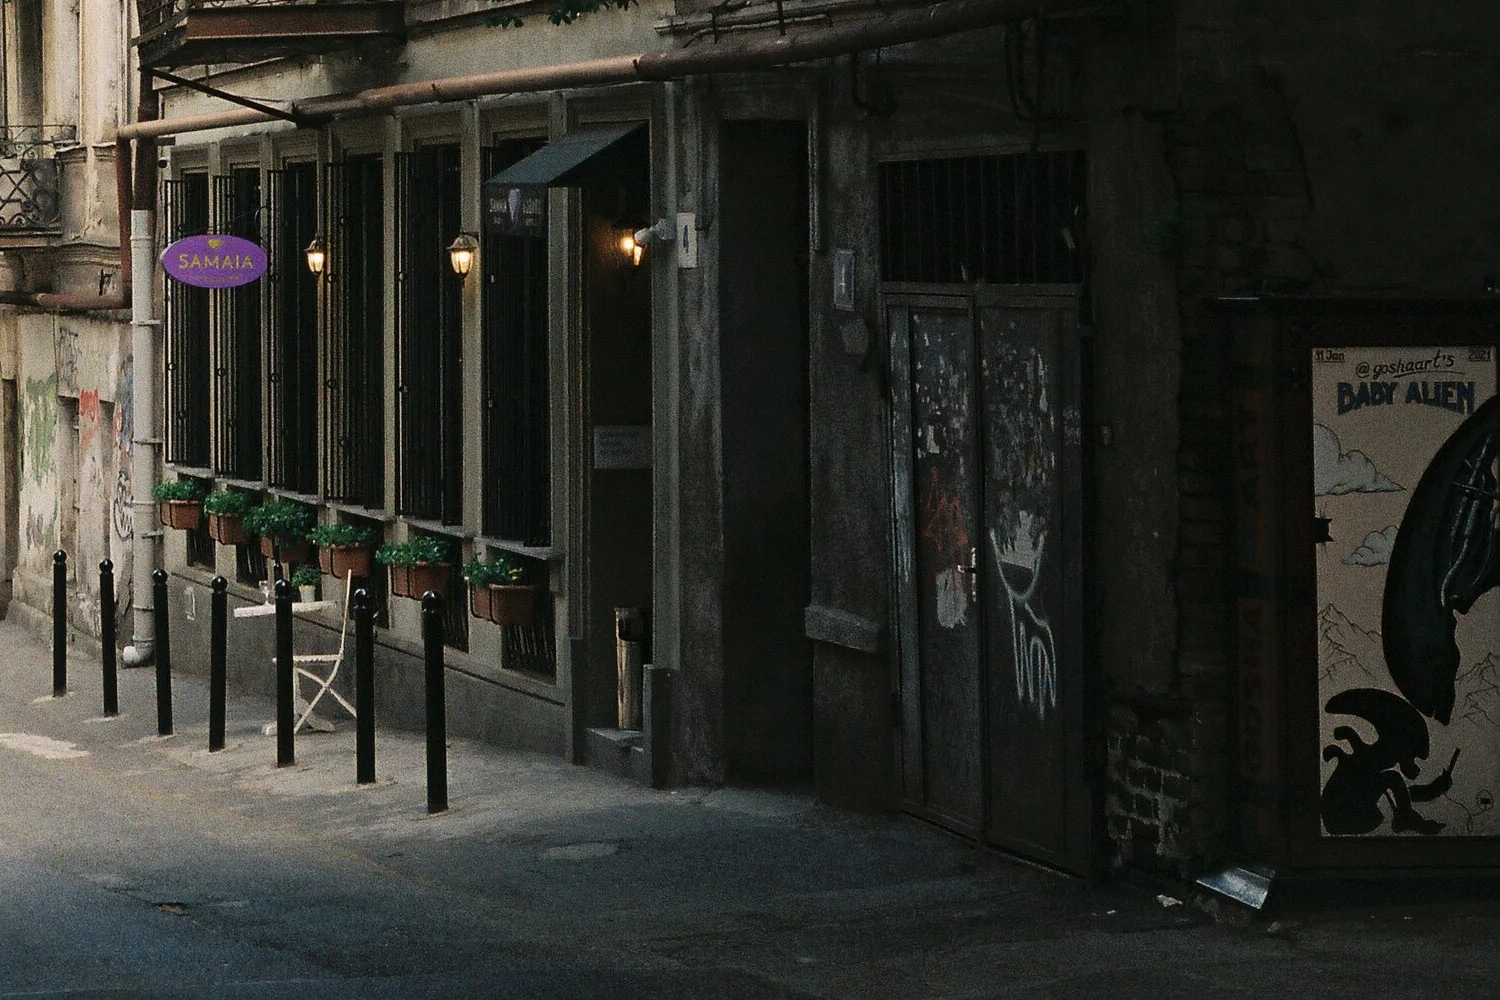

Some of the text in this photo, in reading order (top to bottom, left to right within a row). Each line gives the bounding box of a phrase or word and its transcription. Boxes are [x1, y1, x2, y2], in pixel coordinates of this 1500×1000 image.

[179, 254, 254, 269] SAMAIA
[1325, 350, 1346, 361] Jan
[1468, 348, 1492, 361] 2021
[1338, 381, 1475, 416] BABY ALIEN
